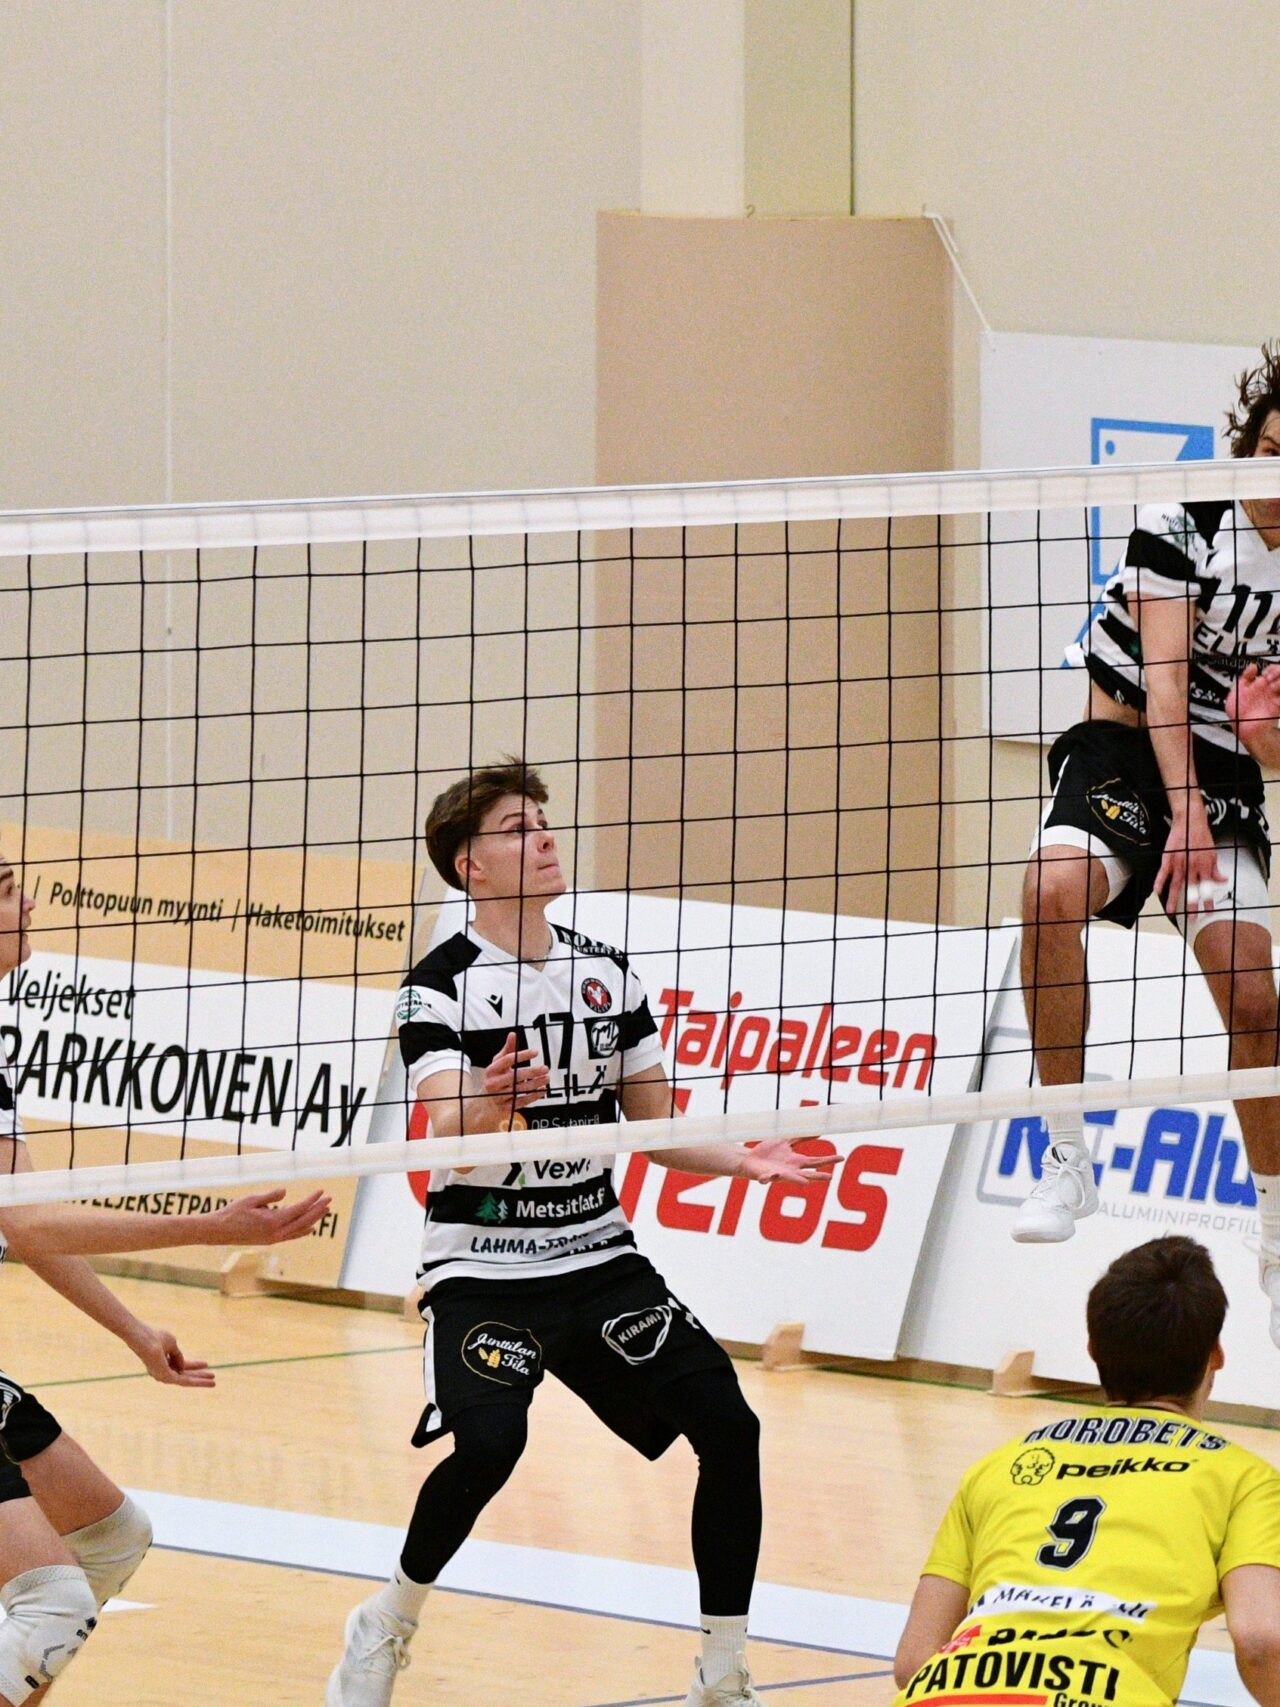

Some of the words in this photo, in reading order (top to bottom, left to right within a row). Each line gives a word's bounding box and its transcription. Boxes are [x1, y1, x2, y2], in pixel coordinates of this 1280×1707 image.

[1223, 584, 1273, 639] 11
[50, 881, 154, 916] Polttopuun
[158, 898, 224, 926] myynti
[248, 902, 405, 942] Haketoimitukset
[7, 969, 136, 1021] Veljekset
[533, 1012, 574, 1071] 17
[657, 988, 938, 1091] Taipaleen
[0, 1025, 293, 1128] PARKKONEN
[297, 1062, 367, 1148] Ay
[1097, 1200, 1262, 1236] ALUMIINIPROFIIL
[467, 1332, 537, 1360] Junttilan
[617, 1311, 662, 1344] KIRAMI
[501, 1353, 531, 1376] Tila
[1056, 1456, 1192, 1482] peikko
[1035, 1495, 1108, 1572] 9
[905, 1650, 1120, 1701] PATOVISTI
